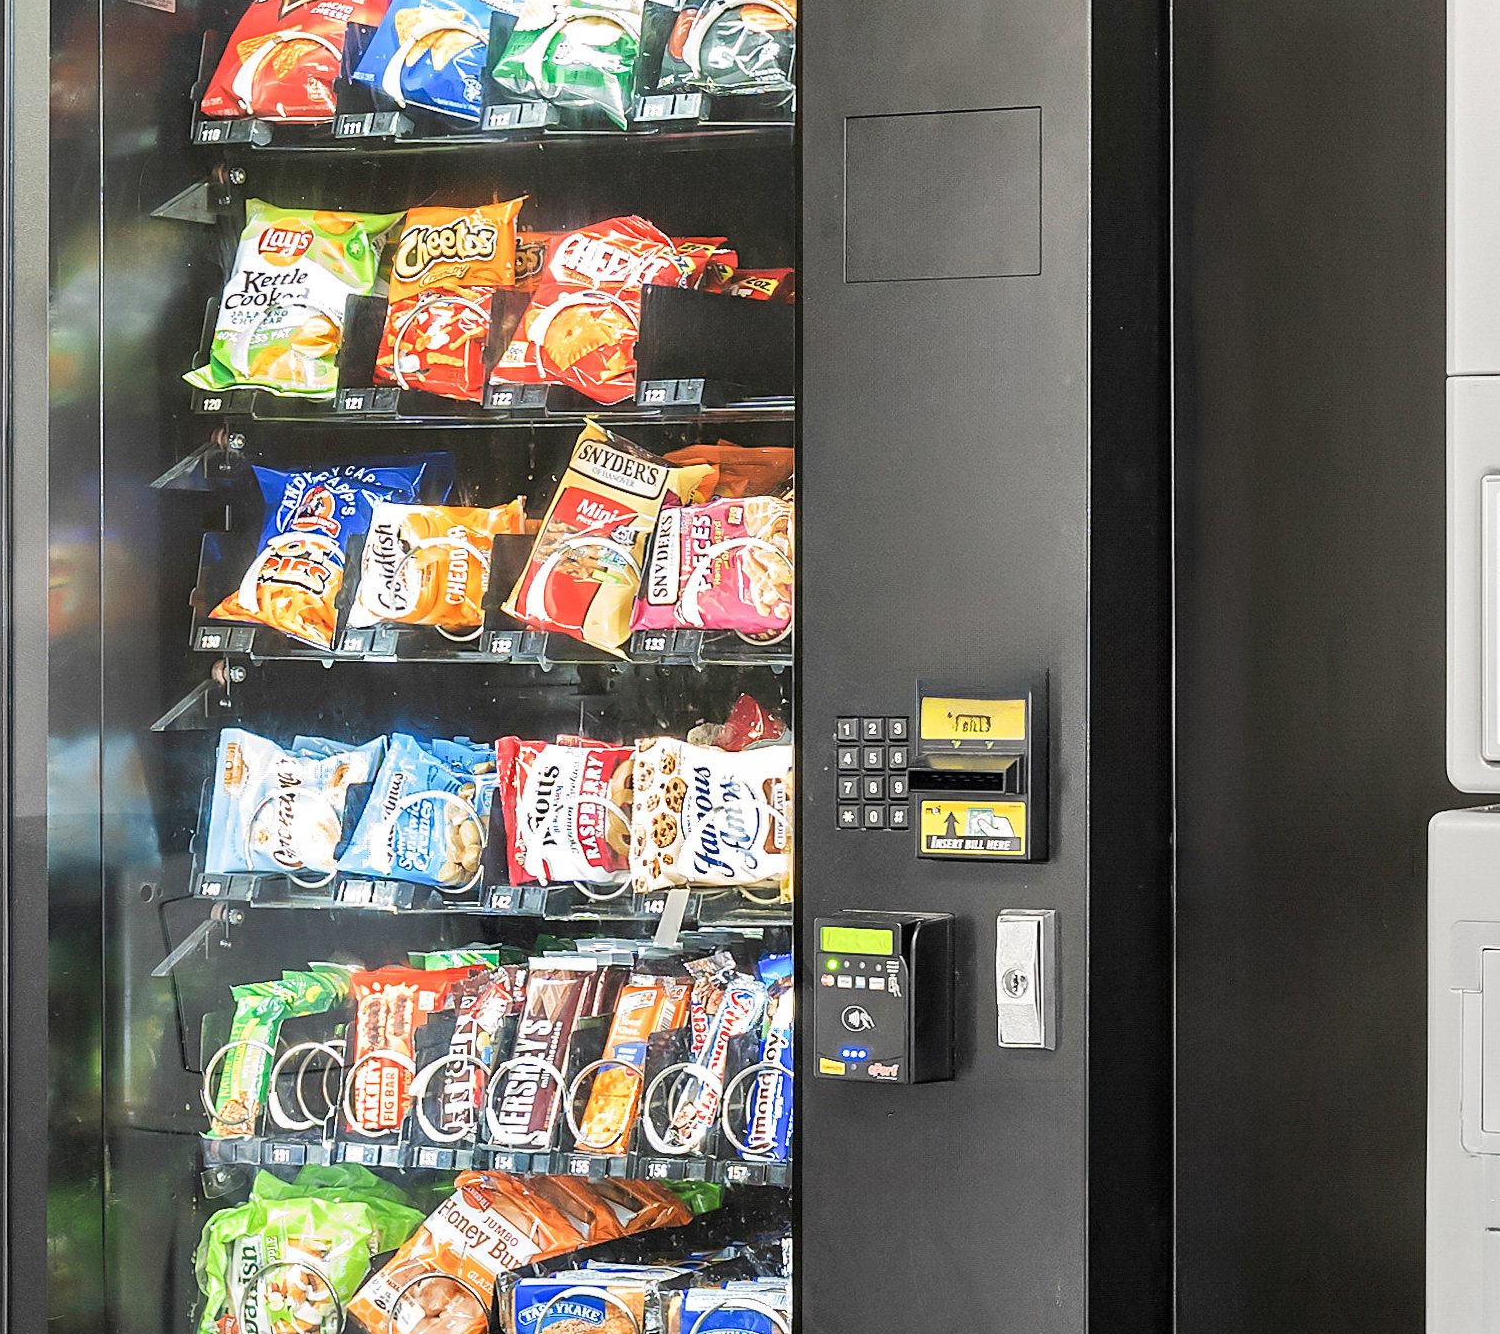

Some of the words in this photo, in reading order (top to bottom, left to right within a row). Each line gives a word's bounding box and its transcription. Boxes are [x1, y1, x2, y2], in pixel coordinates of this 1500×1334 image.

[343, 122, 362, 134] 111
[201, 129, 220, 141] 110
[259, 228, 314, 257] Lay's
[394, 218, 497, 281] Cheetos
[242, 268, 308, 294] Kettle
[492, 392, 512, 405] 122
[644, 390, 666, 402] 123
[203, 399, 222, 411] 120
[345, 397, 363, 409] 121
[578, 443, 660, 486] SNYDER'S
[281, 471, 313, 510] ANDY
[652, 514, 675, 599] SNYDER'S
[201, 635, 221, 648] 130
[492, 640, 512, 652] 132
[644, 638, 665, 650] 133
[844, 724, 850, 735] 1
[869, 723, 876, 735] 2
[894, 723, 901, 734] 3
[844, 753, 851, 764] 4
[869, 753, 876, 764] 5
[894, 753, 901, 764] 6
[844, 782, 852, 793] 7
[870, 782, 877, 793] 8
[895, 782, 902, 793] 9
[870, 811, 877, 822] 0
[930, 836, 964, 850] INSERT
[964, 838, 984, 850] BILL
[986, 840, 1011, 851] HERE
[491, 895, 511, 908] 142
[644, 901, 664, 914] 143
[384, 1072, 397, 1098] BAR
[384, 1100, 397, 1121] FIG
[494, 1157, 513, 1170] 154
[570, 1160, 589, 1174] 155
[648, 1163, 668, 1177] 156
[727, 1166, 748, 1179] 157
[437, 1198, 491, 1249] Honey
[483, 1216, 519, 1247] JUMBO
